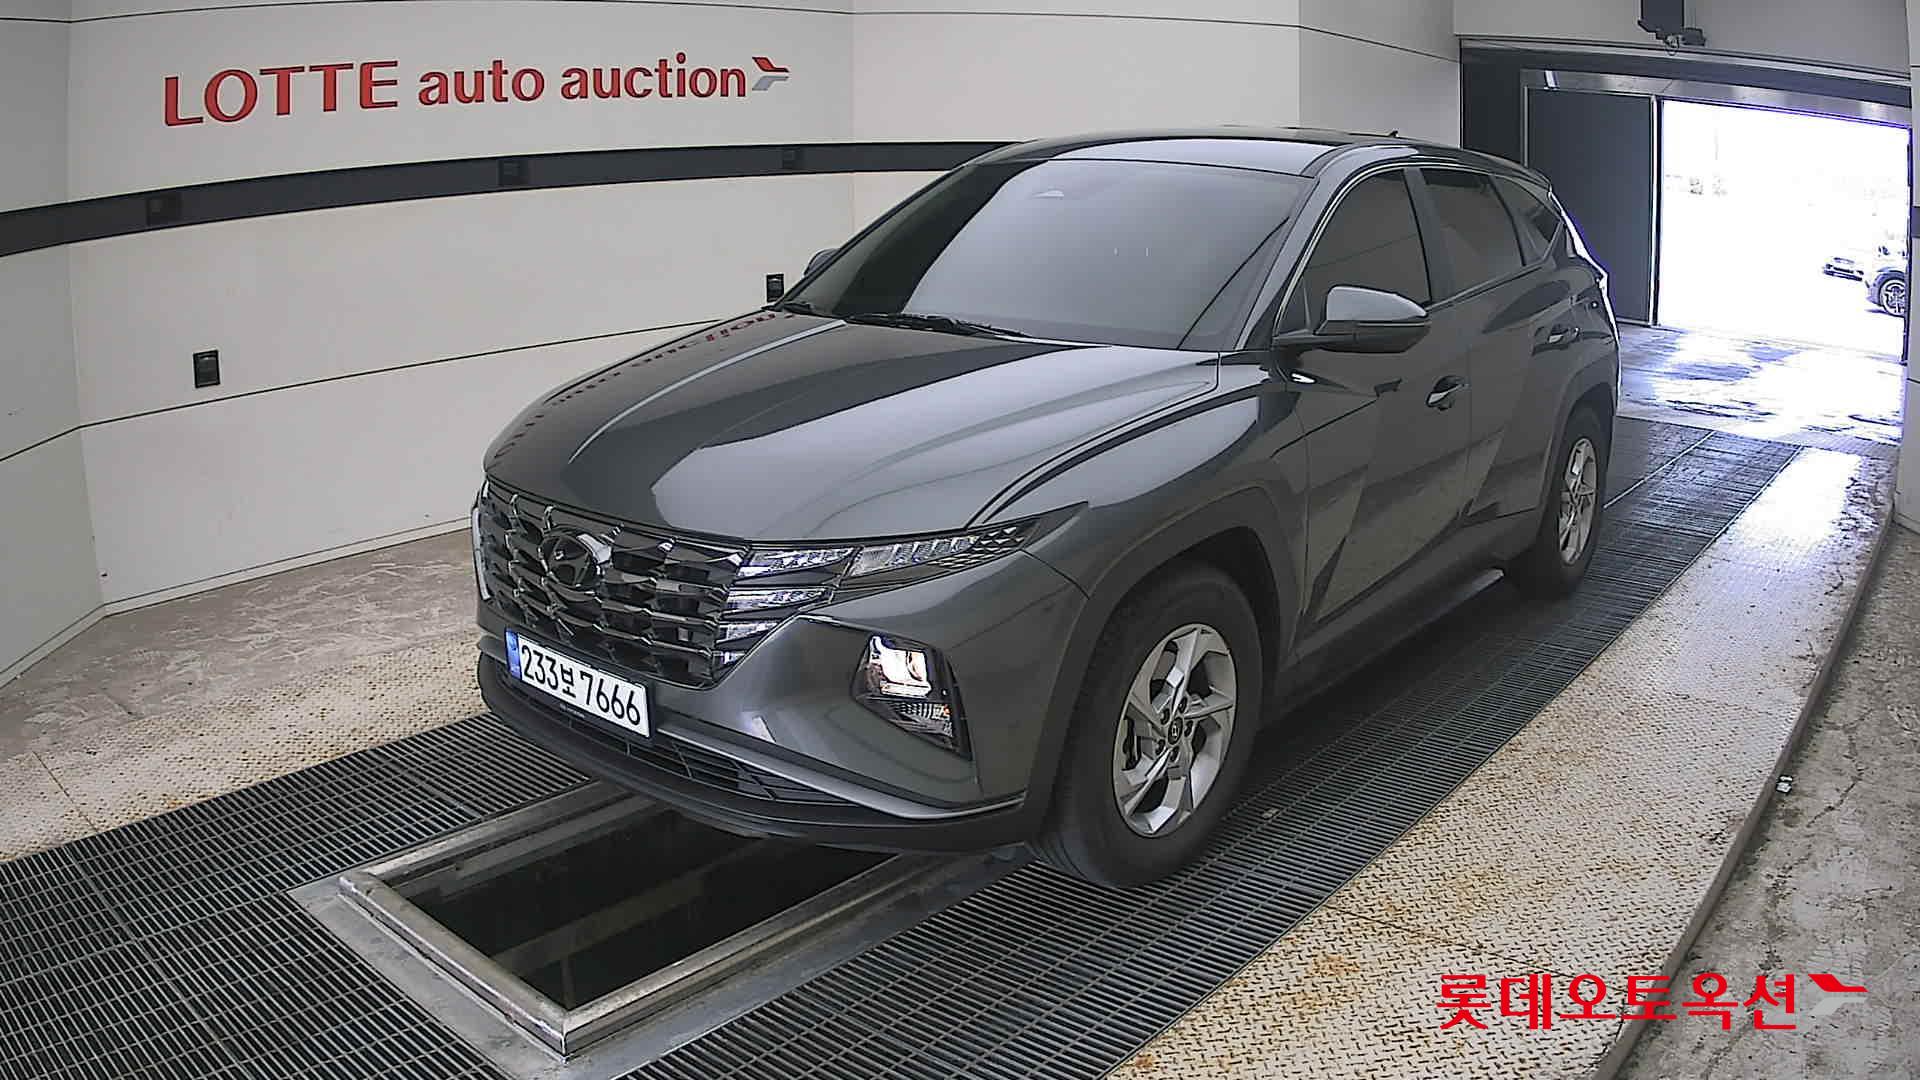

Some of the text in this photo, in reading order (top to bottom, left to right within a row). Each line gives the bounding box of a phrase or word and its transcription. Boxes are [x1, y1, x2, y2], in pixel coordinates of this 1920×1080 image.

[163, 52, 747, 126] LOTTE auto auction
[521, 644, 641, 726] 233보 7666
